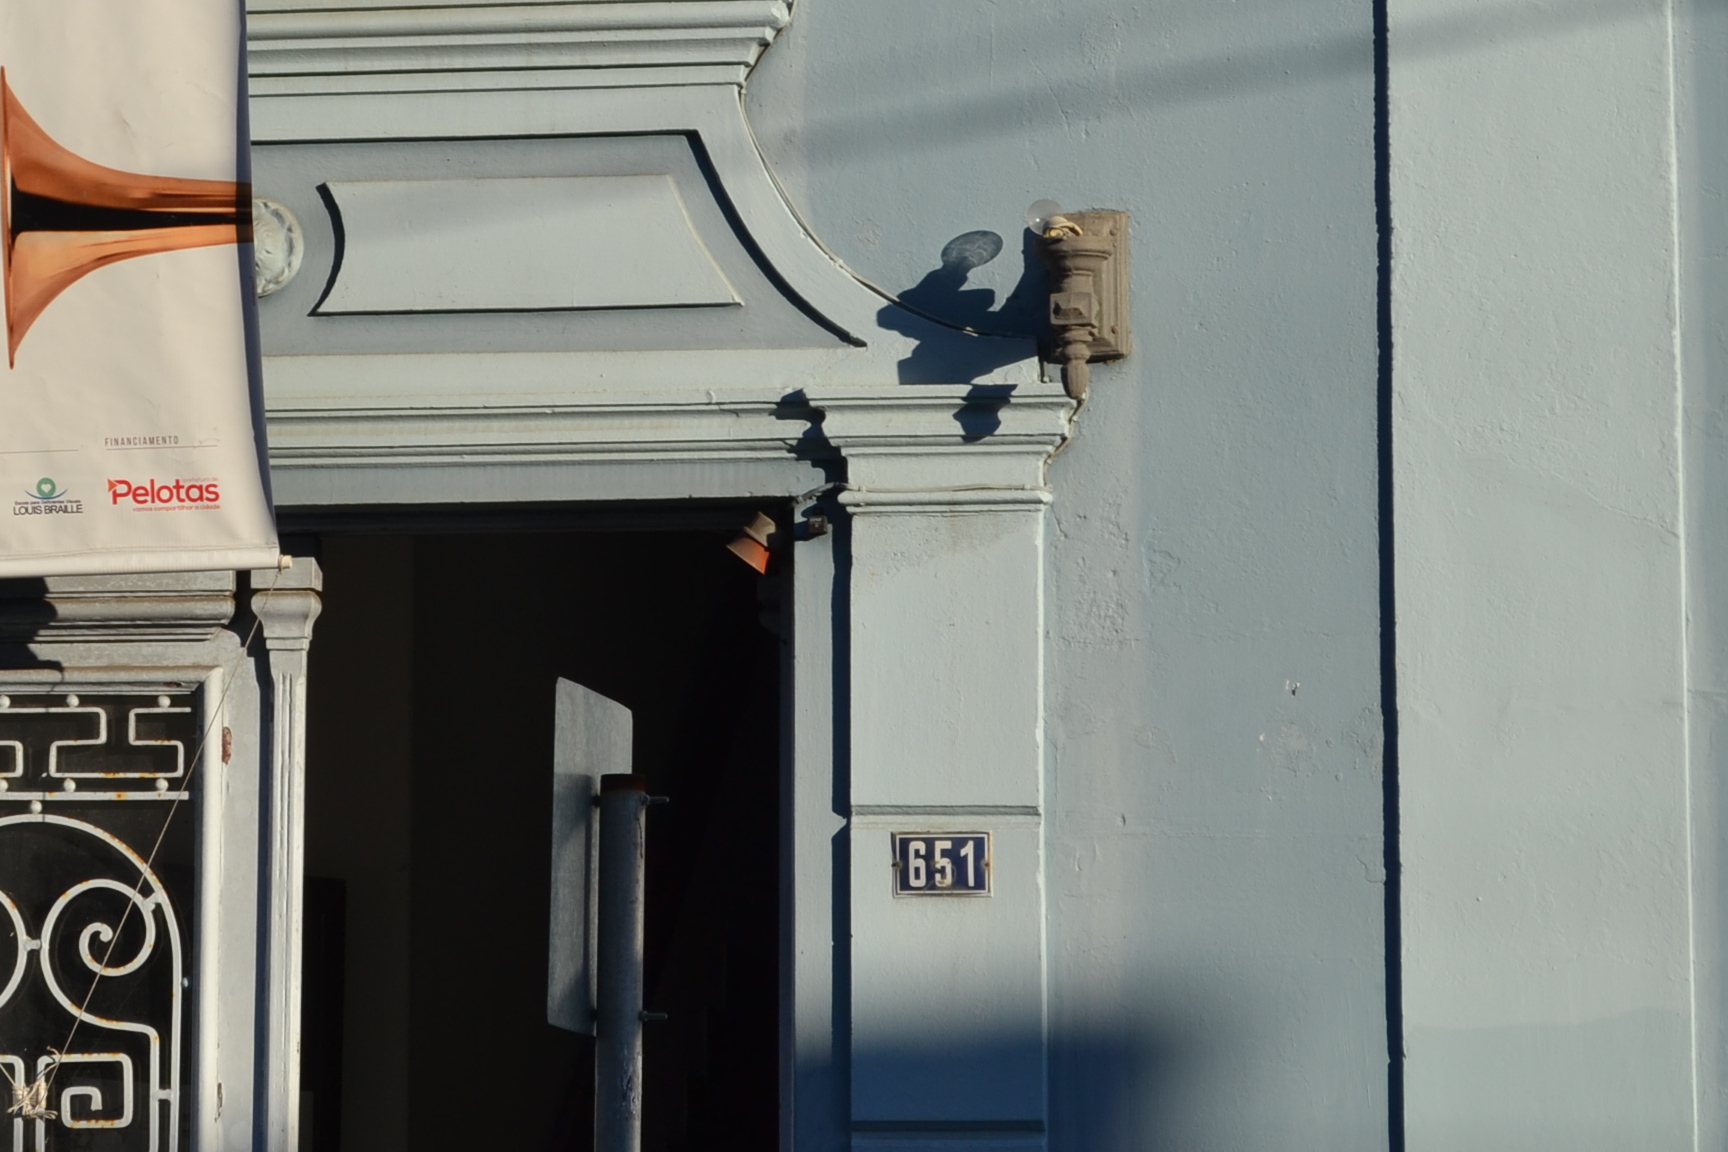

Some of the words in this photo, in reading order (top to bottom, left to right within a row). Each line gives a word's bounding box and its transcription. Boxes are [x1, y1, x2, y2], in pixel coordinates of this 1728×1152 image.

[104, 435, 180, 448] FINANCIAMENTO
[109, 478, 220, 505] Pelotas
[13, 505, 43, 516] LOUIS
[44, 504, 84, 515] BRAILLE
[908, 840, 975, 888] 651
